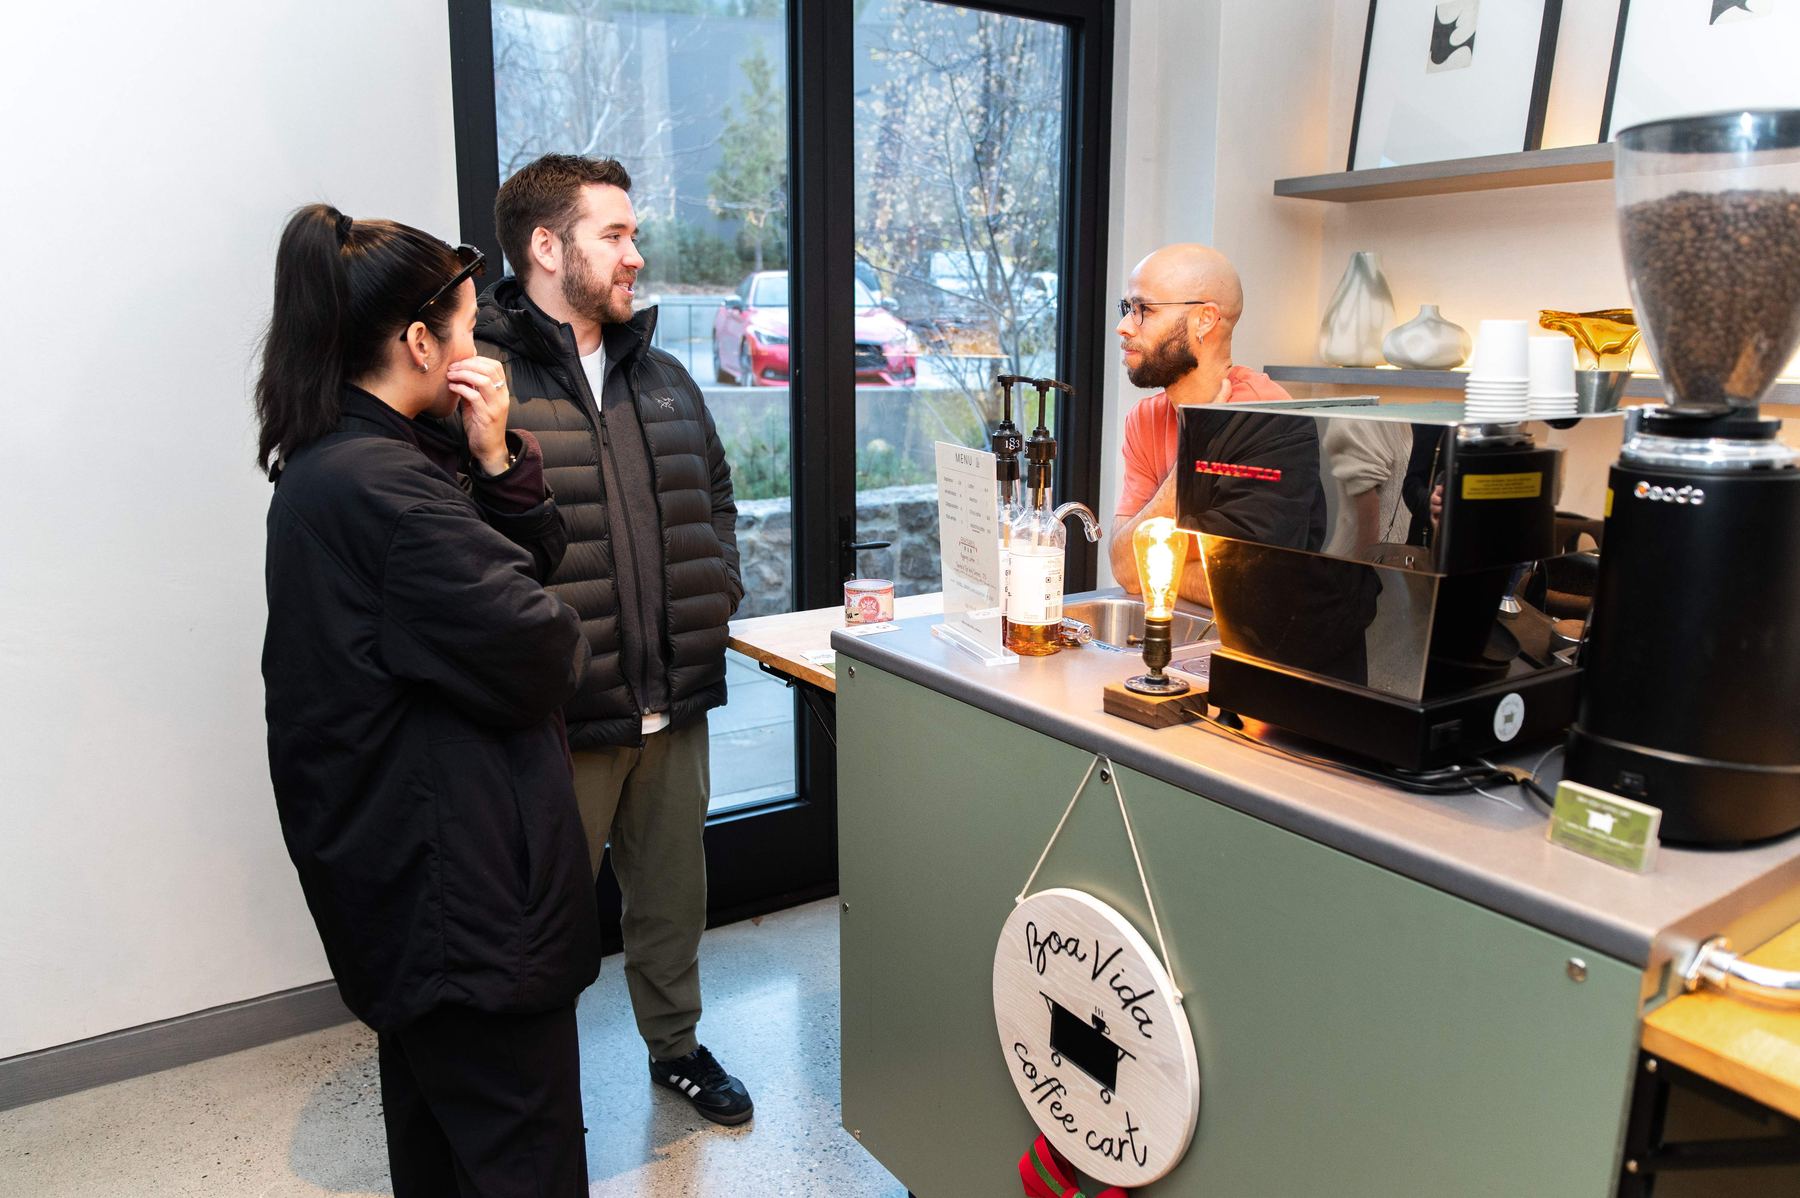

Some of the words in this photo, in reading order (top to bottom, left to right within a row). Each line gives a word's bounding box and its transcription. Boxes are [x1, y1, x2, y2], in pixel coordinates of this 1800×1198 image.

[955, 452, 973, 466] MENU
[1005, 437, 1021, 450] 183
[1025, 921, 1087, 976] Boa
[1091, 939, 1155, 1040] Vida
[1013, 1041, 1079, 1135] coffee
[1085, 1110, 1148, 1168] cart
